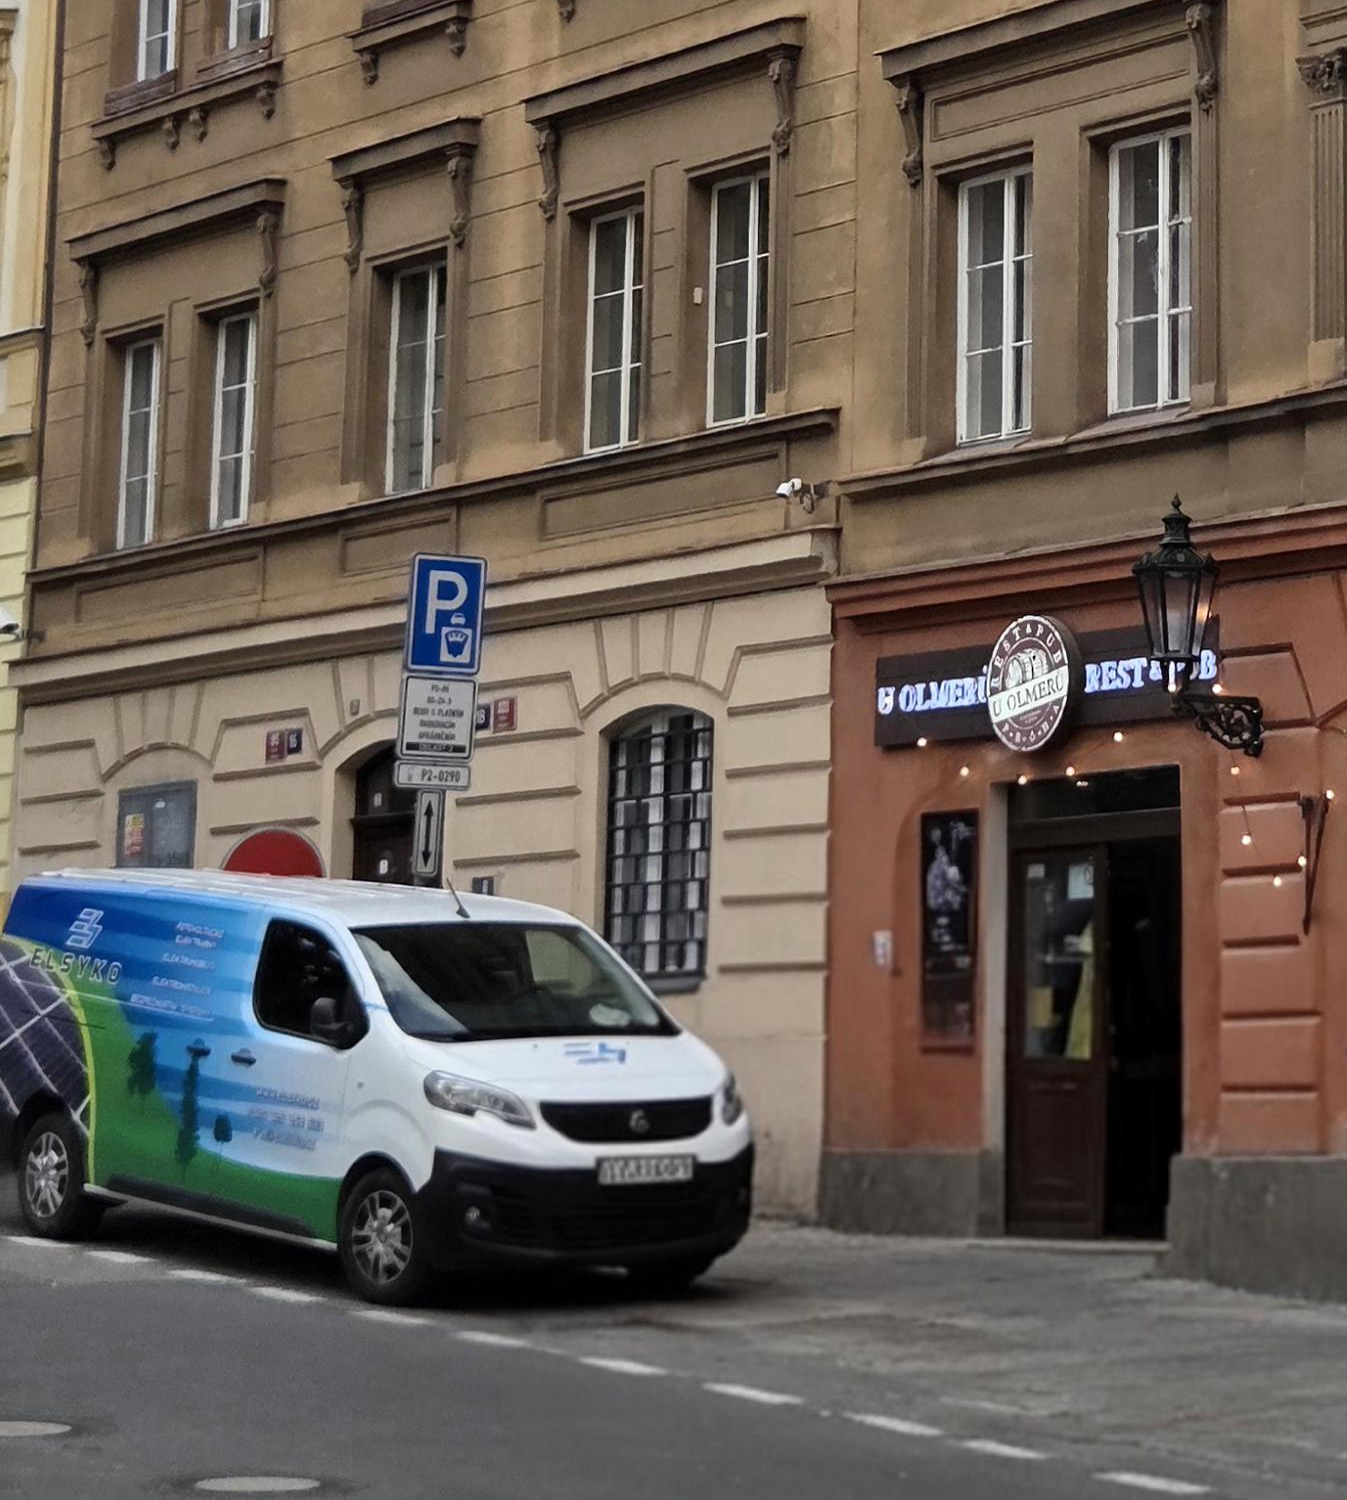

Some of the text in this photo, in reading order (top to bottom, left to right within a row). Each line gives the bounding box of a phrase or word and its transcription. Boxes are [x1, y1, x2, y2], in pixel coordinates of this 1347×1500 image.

[425, 569, 468, 634] P
[878, 687, 895, 715] U
[992, 699, 1003, 717] U
[421, 768, 461, 783] P2-0290
[29, 947, 122, 986] ELSYKO
